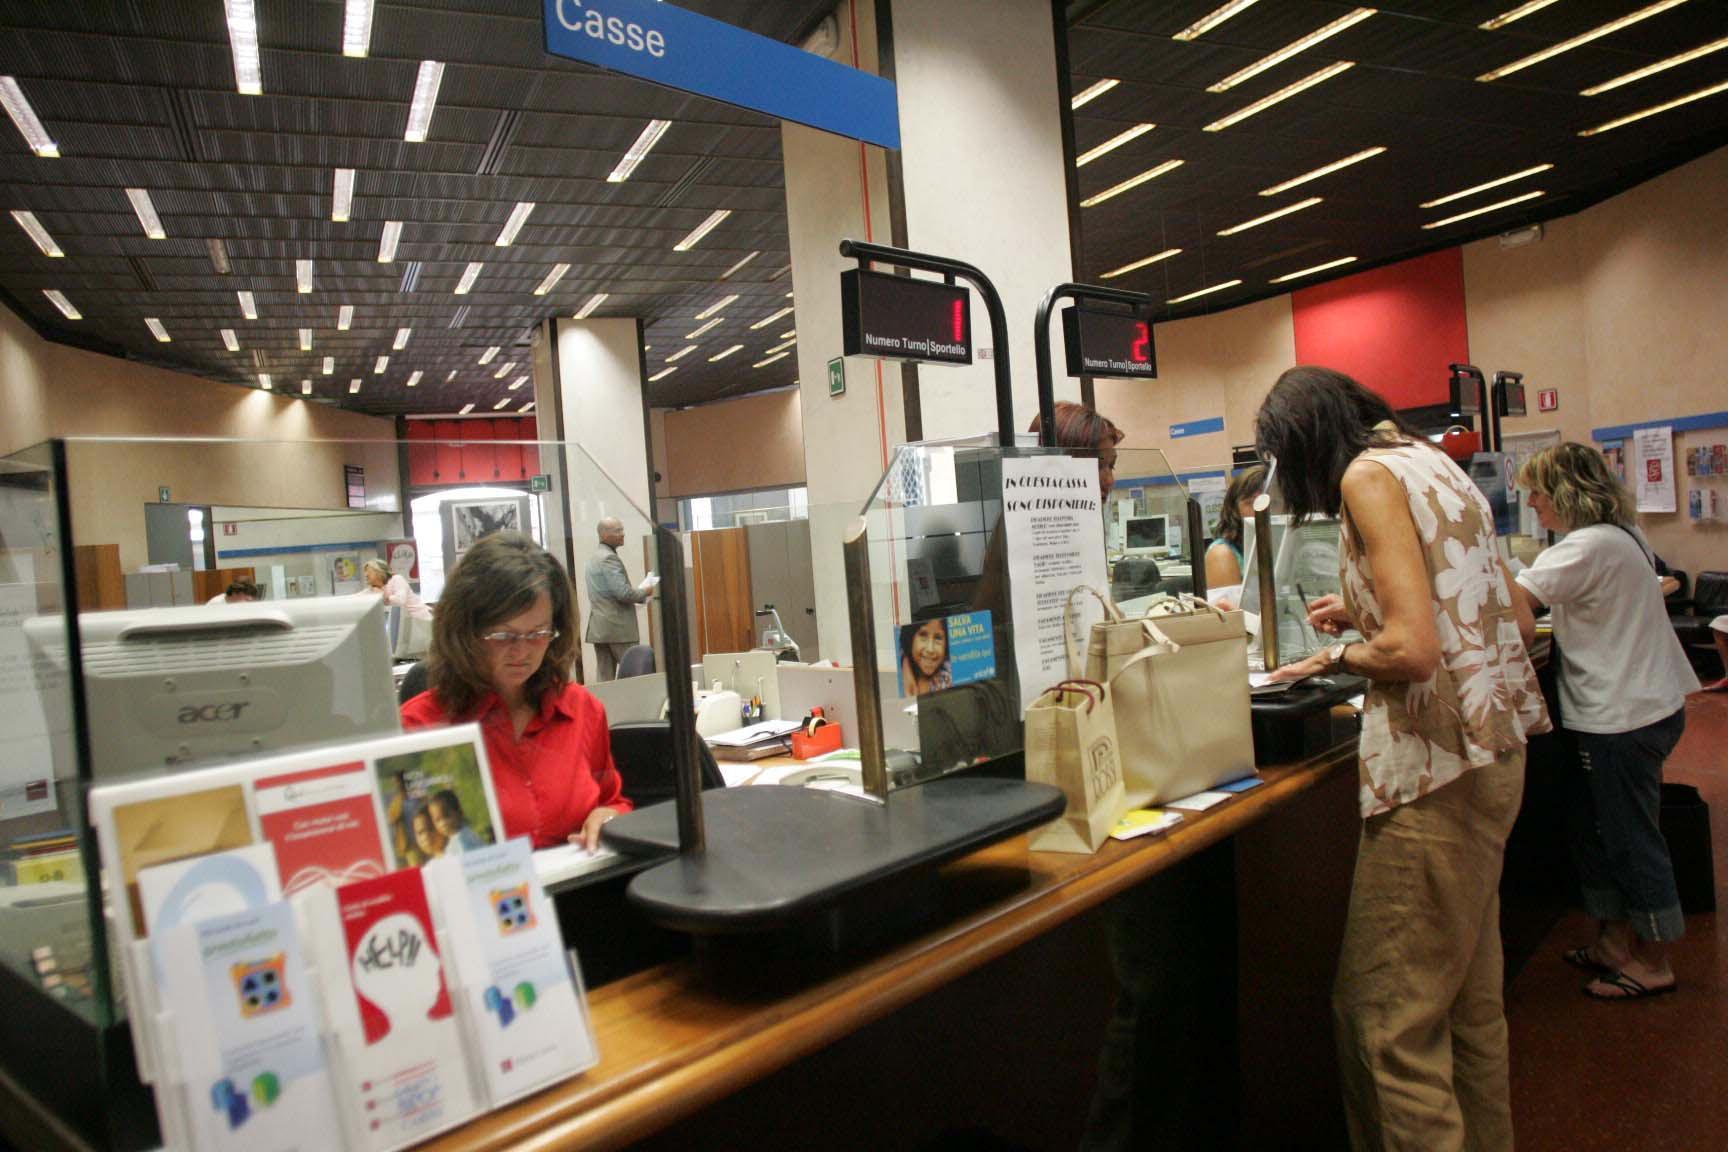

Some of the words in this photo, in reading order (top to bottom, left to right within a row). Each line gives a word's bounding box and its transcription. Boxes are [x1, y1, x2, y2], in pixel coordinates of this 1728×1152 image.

[556, 0, 665, 57] Casse
[865, 332, 901, 349] Numero
[1132, 323, 1149, 361] 2
[1084, 357, 1108, 369] Numero
[177, 702, 249, 724] acer
